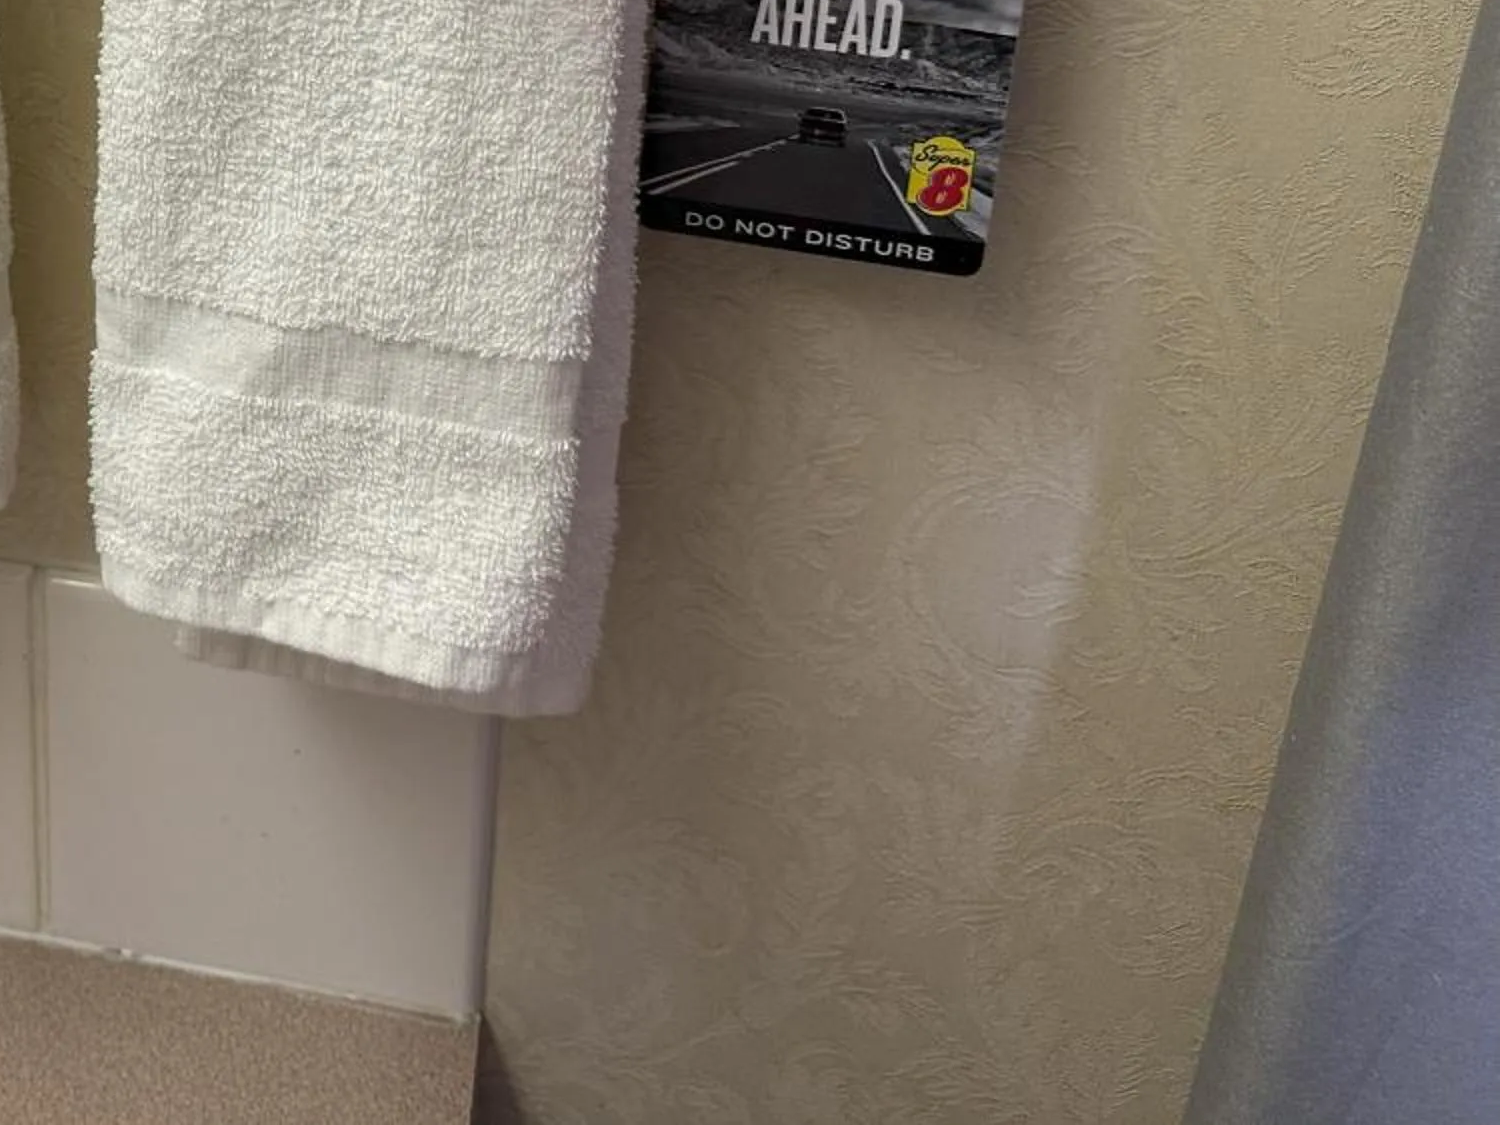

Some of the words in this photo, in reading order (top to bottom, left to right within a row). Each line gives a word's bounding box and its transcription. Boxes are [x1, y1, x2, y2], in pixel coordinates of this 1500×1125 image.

[915, 144, 970, 171] Super
[916, 166, 970, 215] 8
[685, 212, 724, 231] DO
[735, 220, 796, 242] NOT
[805, 229, 934, 263] DISTURB
